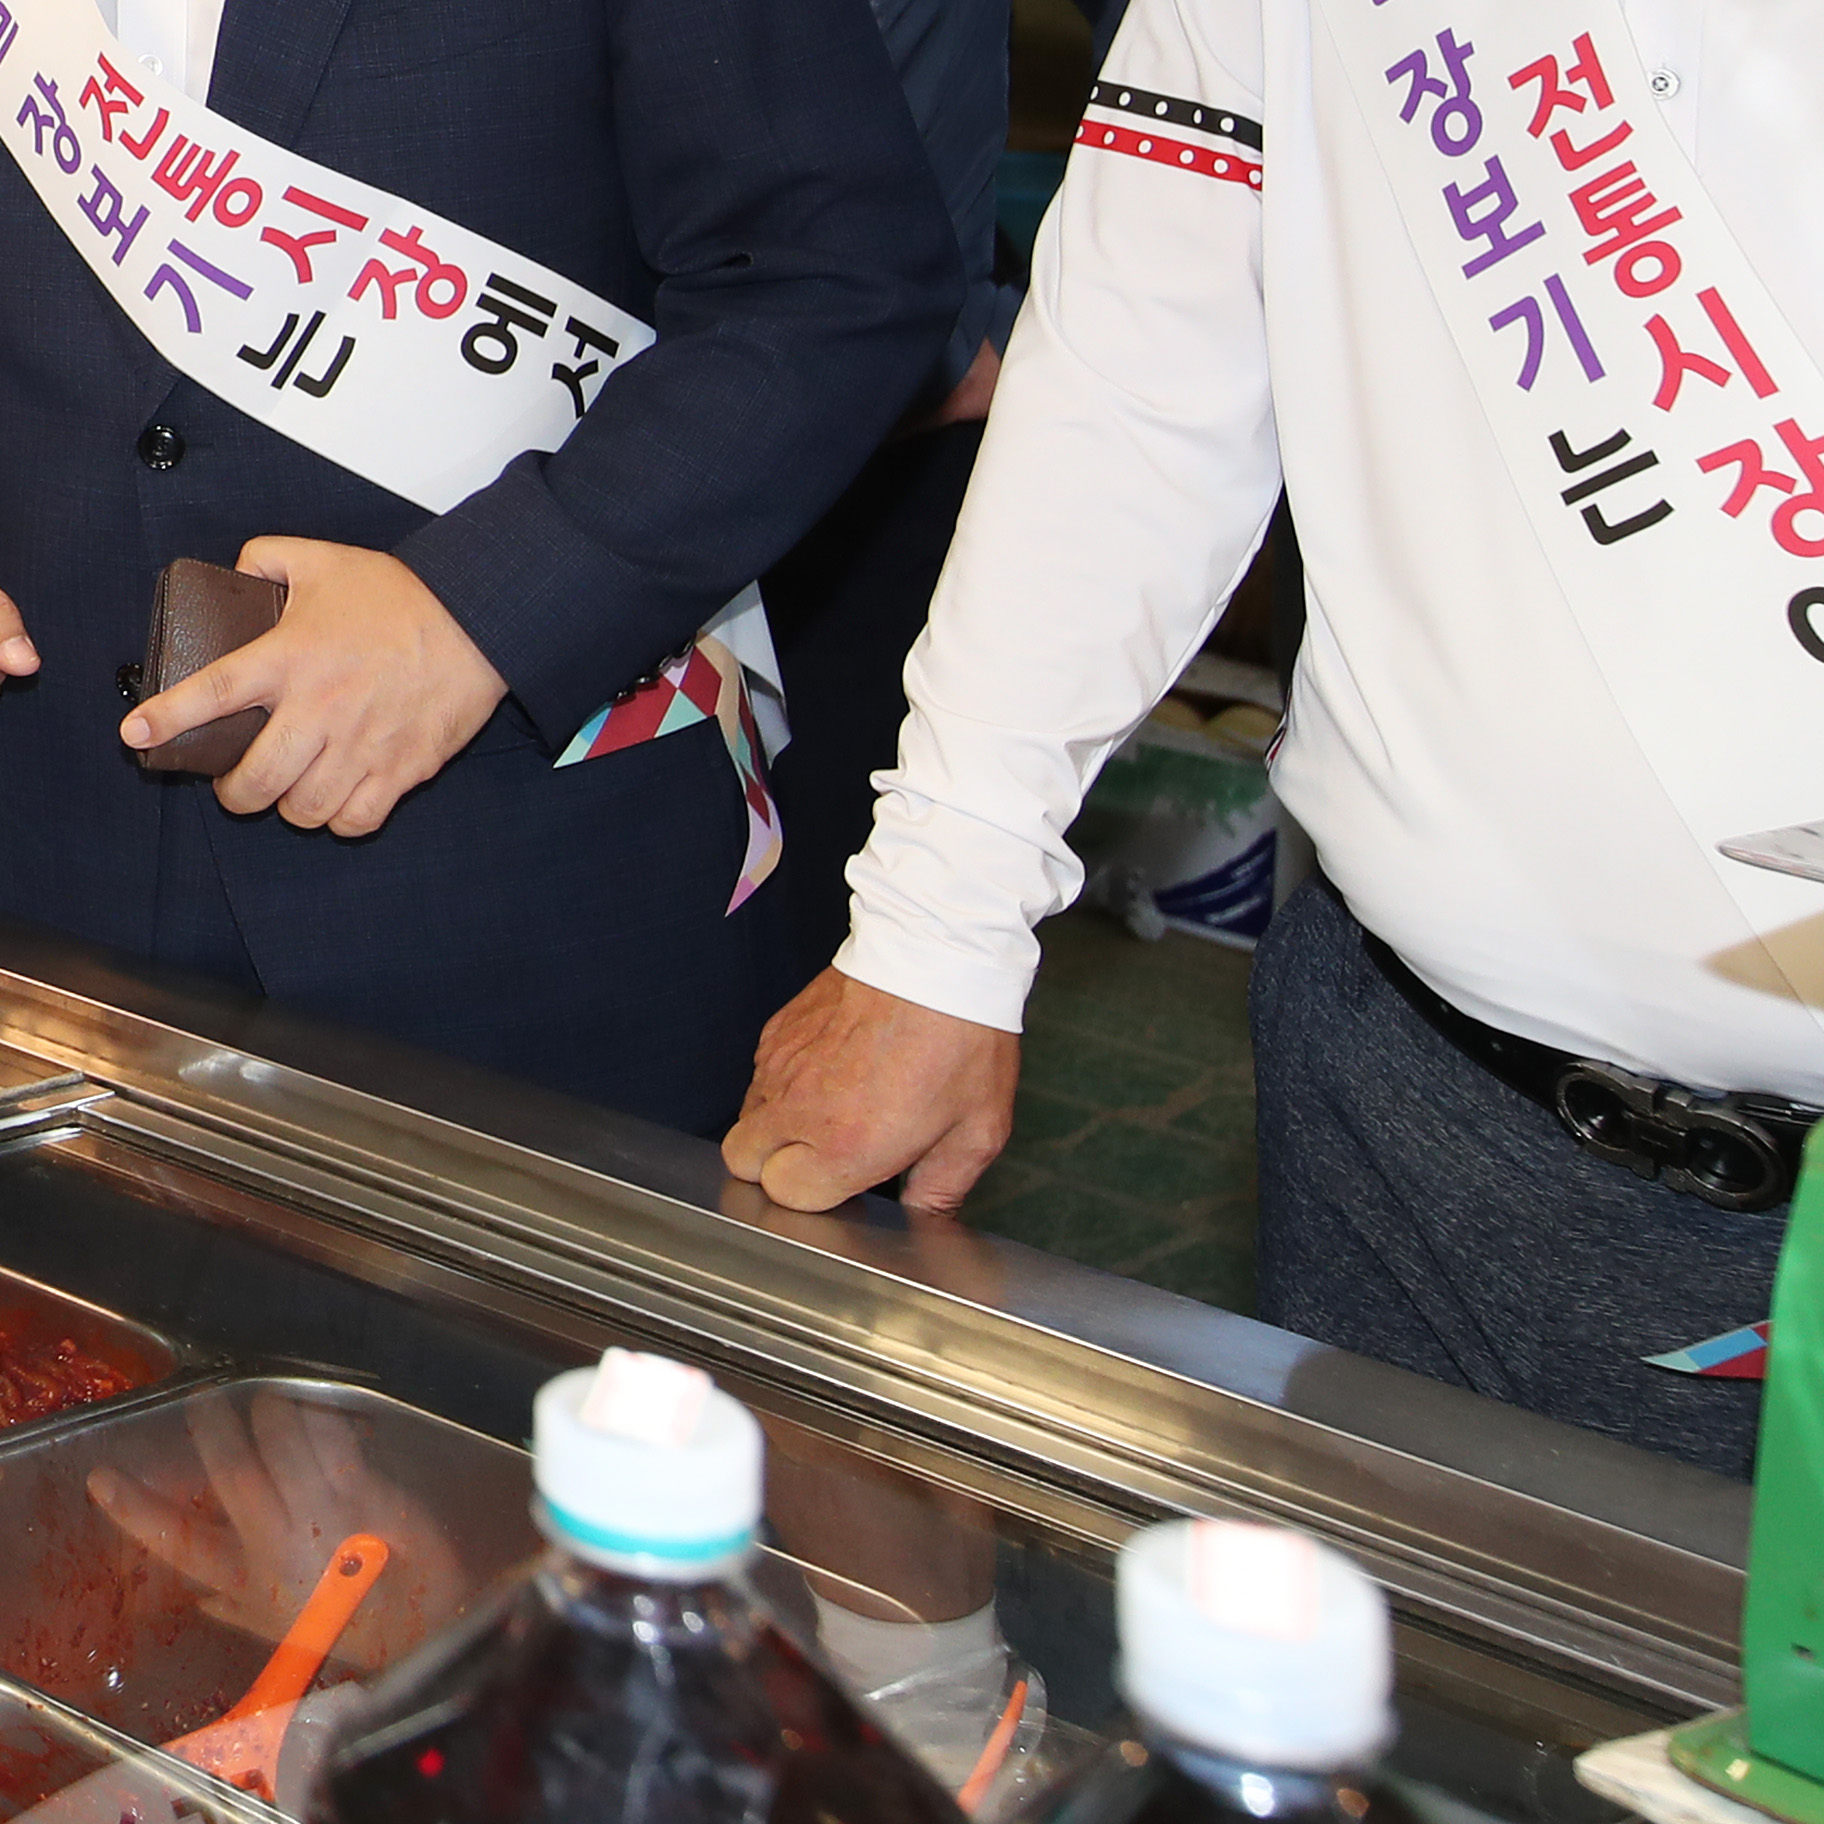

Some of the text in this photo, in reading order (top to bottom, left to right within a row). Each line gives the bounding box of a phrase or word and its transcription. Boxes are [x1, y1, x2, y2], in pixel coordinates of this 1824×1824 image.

[16, 71, 356, 399] 장보기는
[80, 52, 620, 419] 전통시장에서
[1385, 28, 1673, 546] 장보기는
